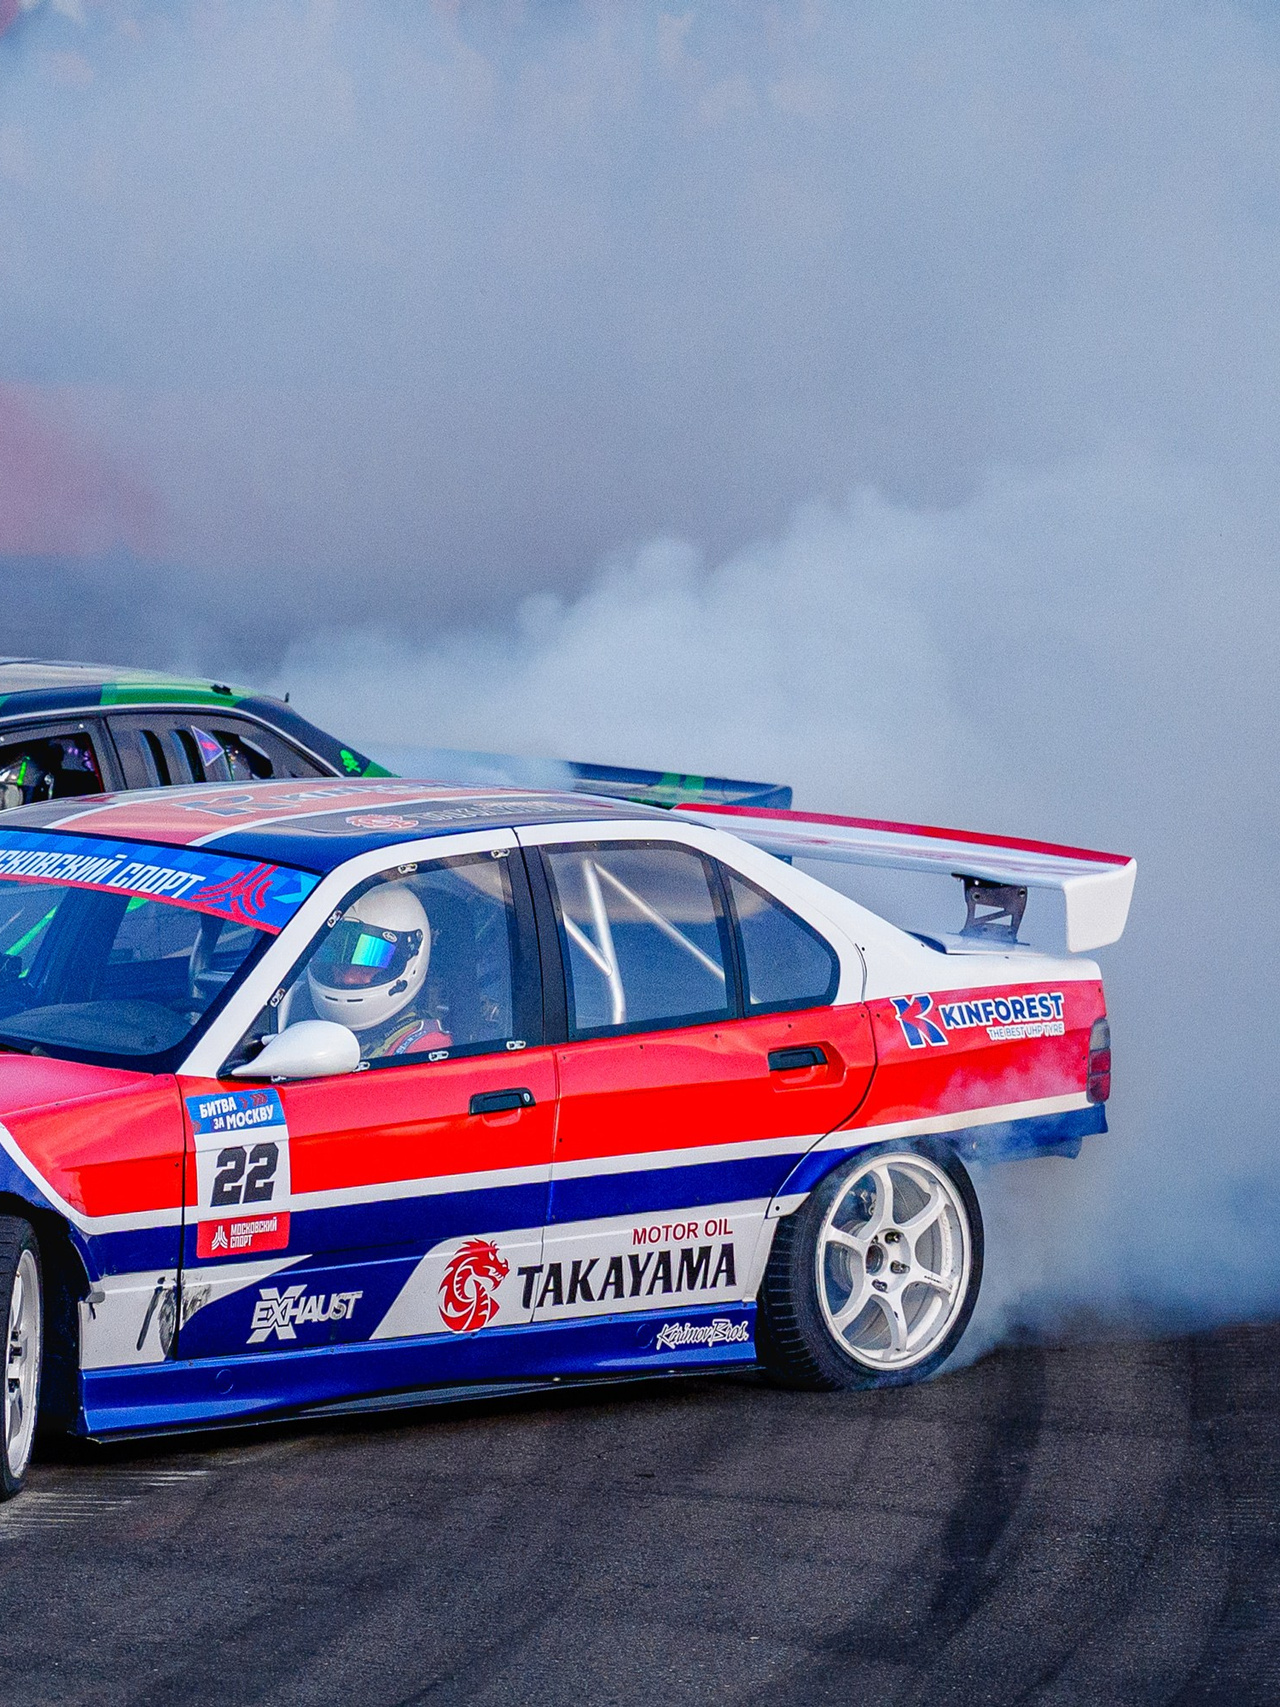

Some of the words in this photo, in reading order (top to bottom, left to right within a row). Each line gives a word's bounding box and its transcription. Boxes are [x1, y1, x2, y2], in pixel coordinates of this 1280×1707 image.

[106, 862, 207, 898] СПОРТ
[938, 992, 1064, 1029] KINFOREST
[987, 1027, 1004, 1039] THE
[1005, 1025, 1025, 1038] BEST
[1025, 1023, 1043, 1037] UHP
[1043, 1022, 1064, 1036] TYRE
[199, 1096, 237, 1119] БИТВА
[213, 1116, 225, 1130] ЗА
[226, 1104, 274, 1130] МОСКВУ
[210, 1142, 279, 1207] 22
[230, 1216, 277, 1236] МОСКОВСКИЙ
[633, 1221, 699, 1245] MOTOR
[704, 1218, 734, 1237] OIL
[230, 1234, 253, 1248] СПОРТ
[517, 1243, 737, 1309] TAKAYAMA
[246, 1284, 363, 1344] EXHAUST
